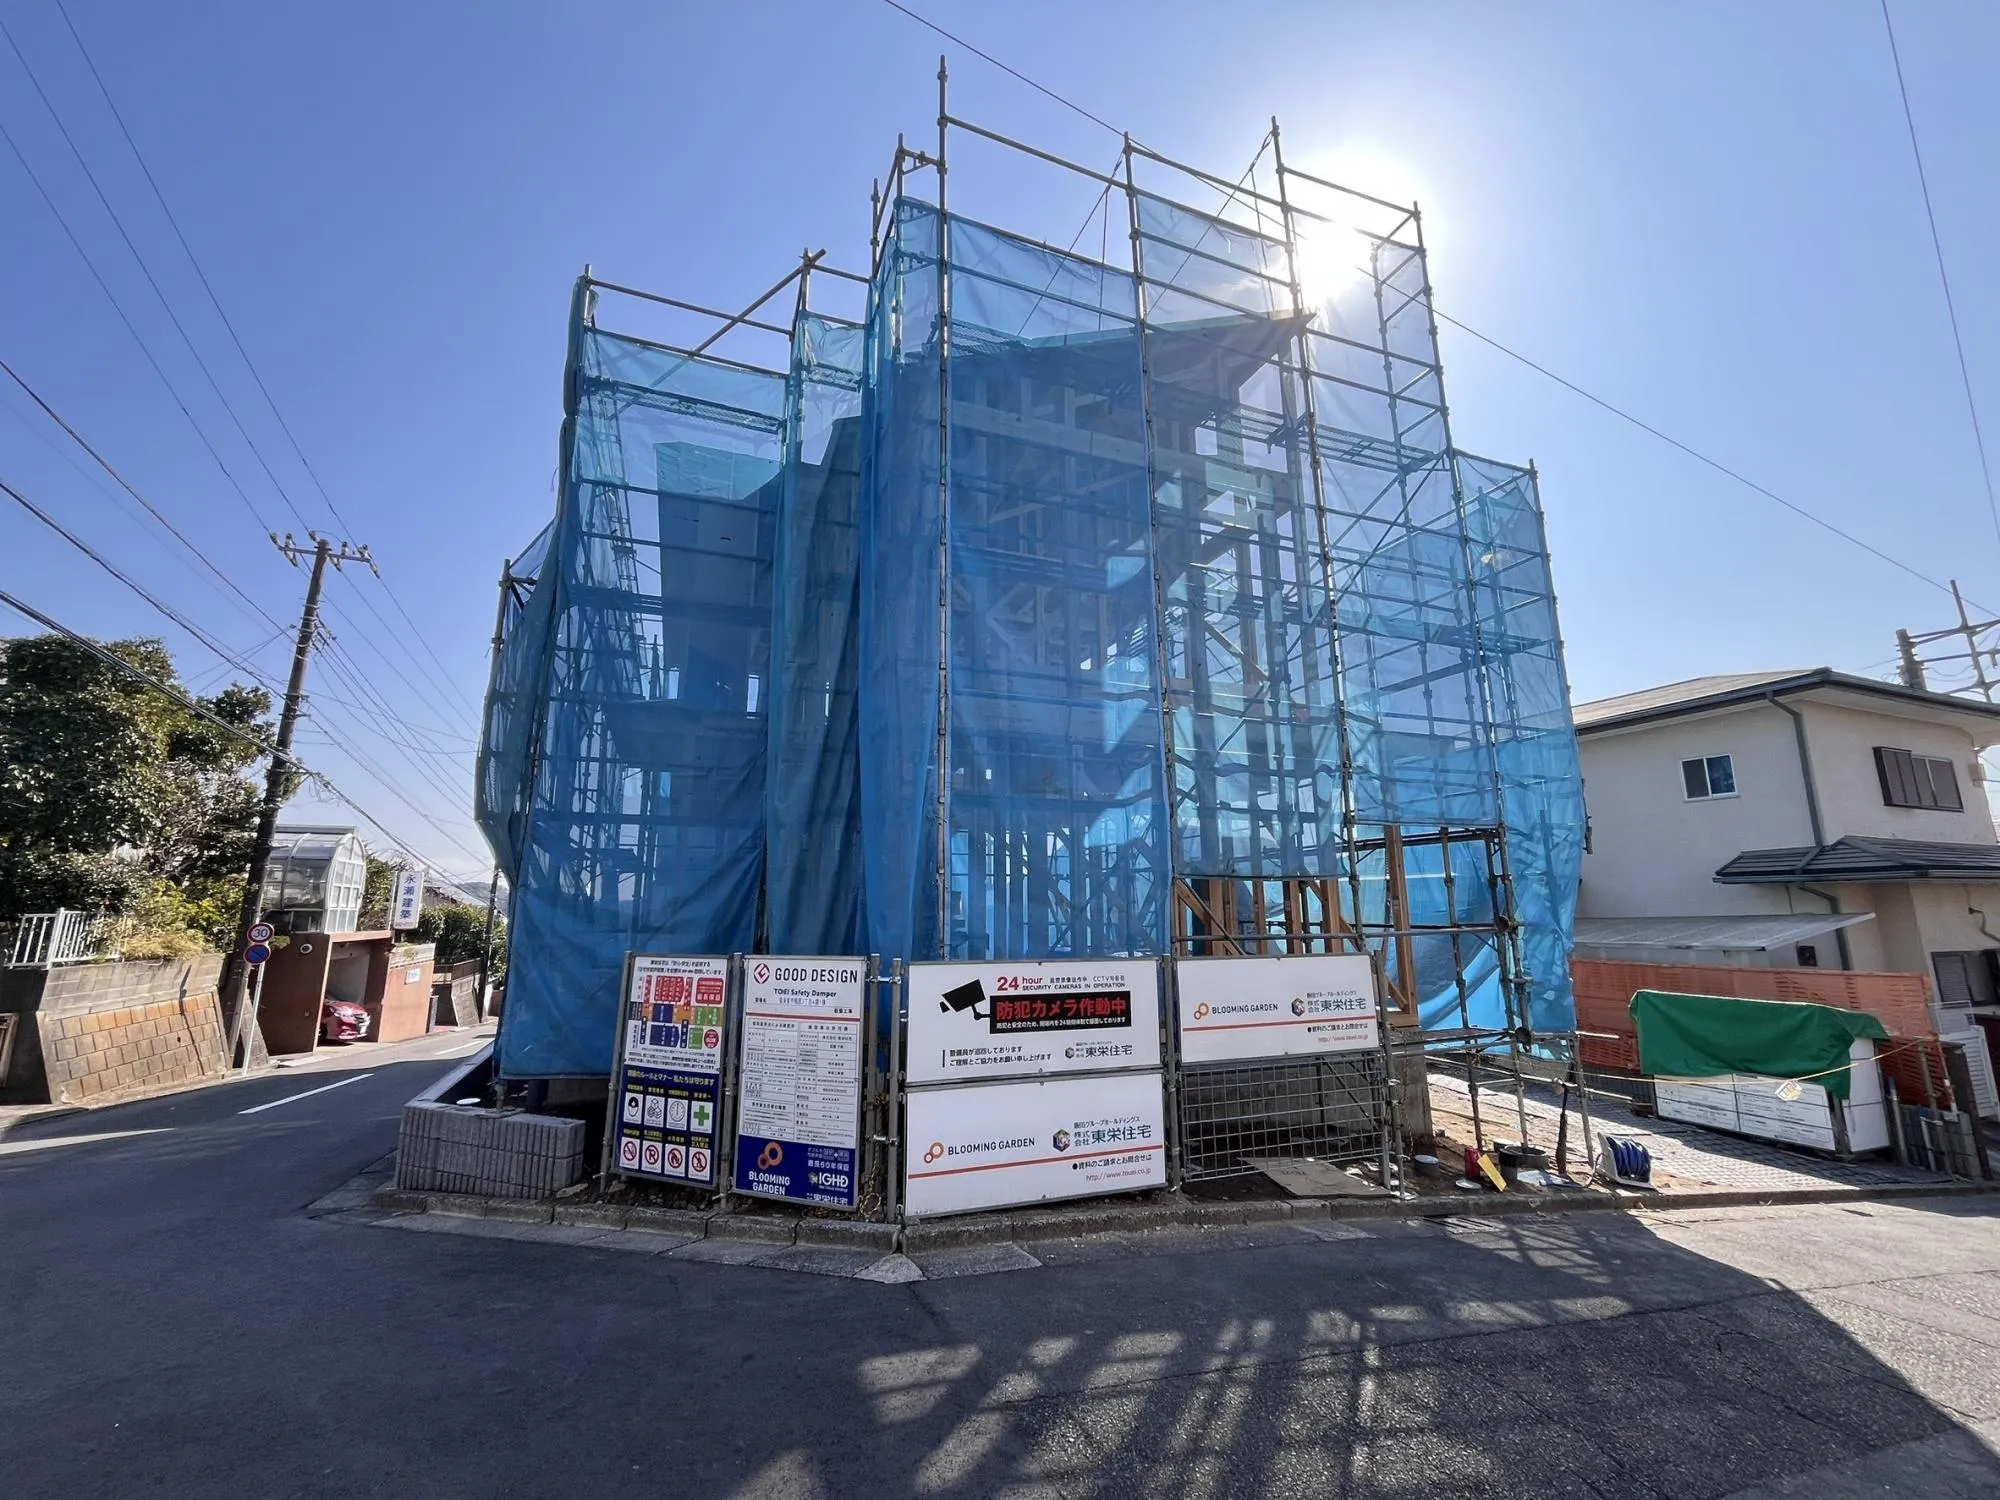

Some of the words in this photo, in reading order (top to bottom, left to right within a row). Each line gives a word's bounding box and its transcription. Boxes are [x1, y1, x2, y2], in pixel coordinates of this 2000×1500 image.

[253, 929, 268, 938] 30
[775, 968, 807, 982] GOOD
[811, 969, 858, 983] DESIGN
[997, 976, 1019, 991] 24
[1022, 976, 1043, 985] hour
[791, 989, 810, 997] Safety
[811, 990, 837, 998] Damper
[996, 997, 1127, 1020] 防犯カメラ作動中
[1212, 1005, 1250, 1014] BLOOMING
[1250, 1003, 1278, 1012] GARDEN
[1320, 998, 1367, 1012] 東栄住宅
[1085, 1044, 1133, 1058] 東栄住宅
[1074, 1130, 1090, 1138] 株式
[1091, 1124, 1152, 1144] 東栄住宅
[948, 1141, 997, 1155] BLOOMING
[998, 1137, 1035, 1149] GARDEN
[1074, 1138, 1090, 1147] 会社
[748, 1171, 790, 1186] BLOOMING
[819, 1172, 849, 1188] IGHD
[752, 1182, 786, 1195] GARDEN
